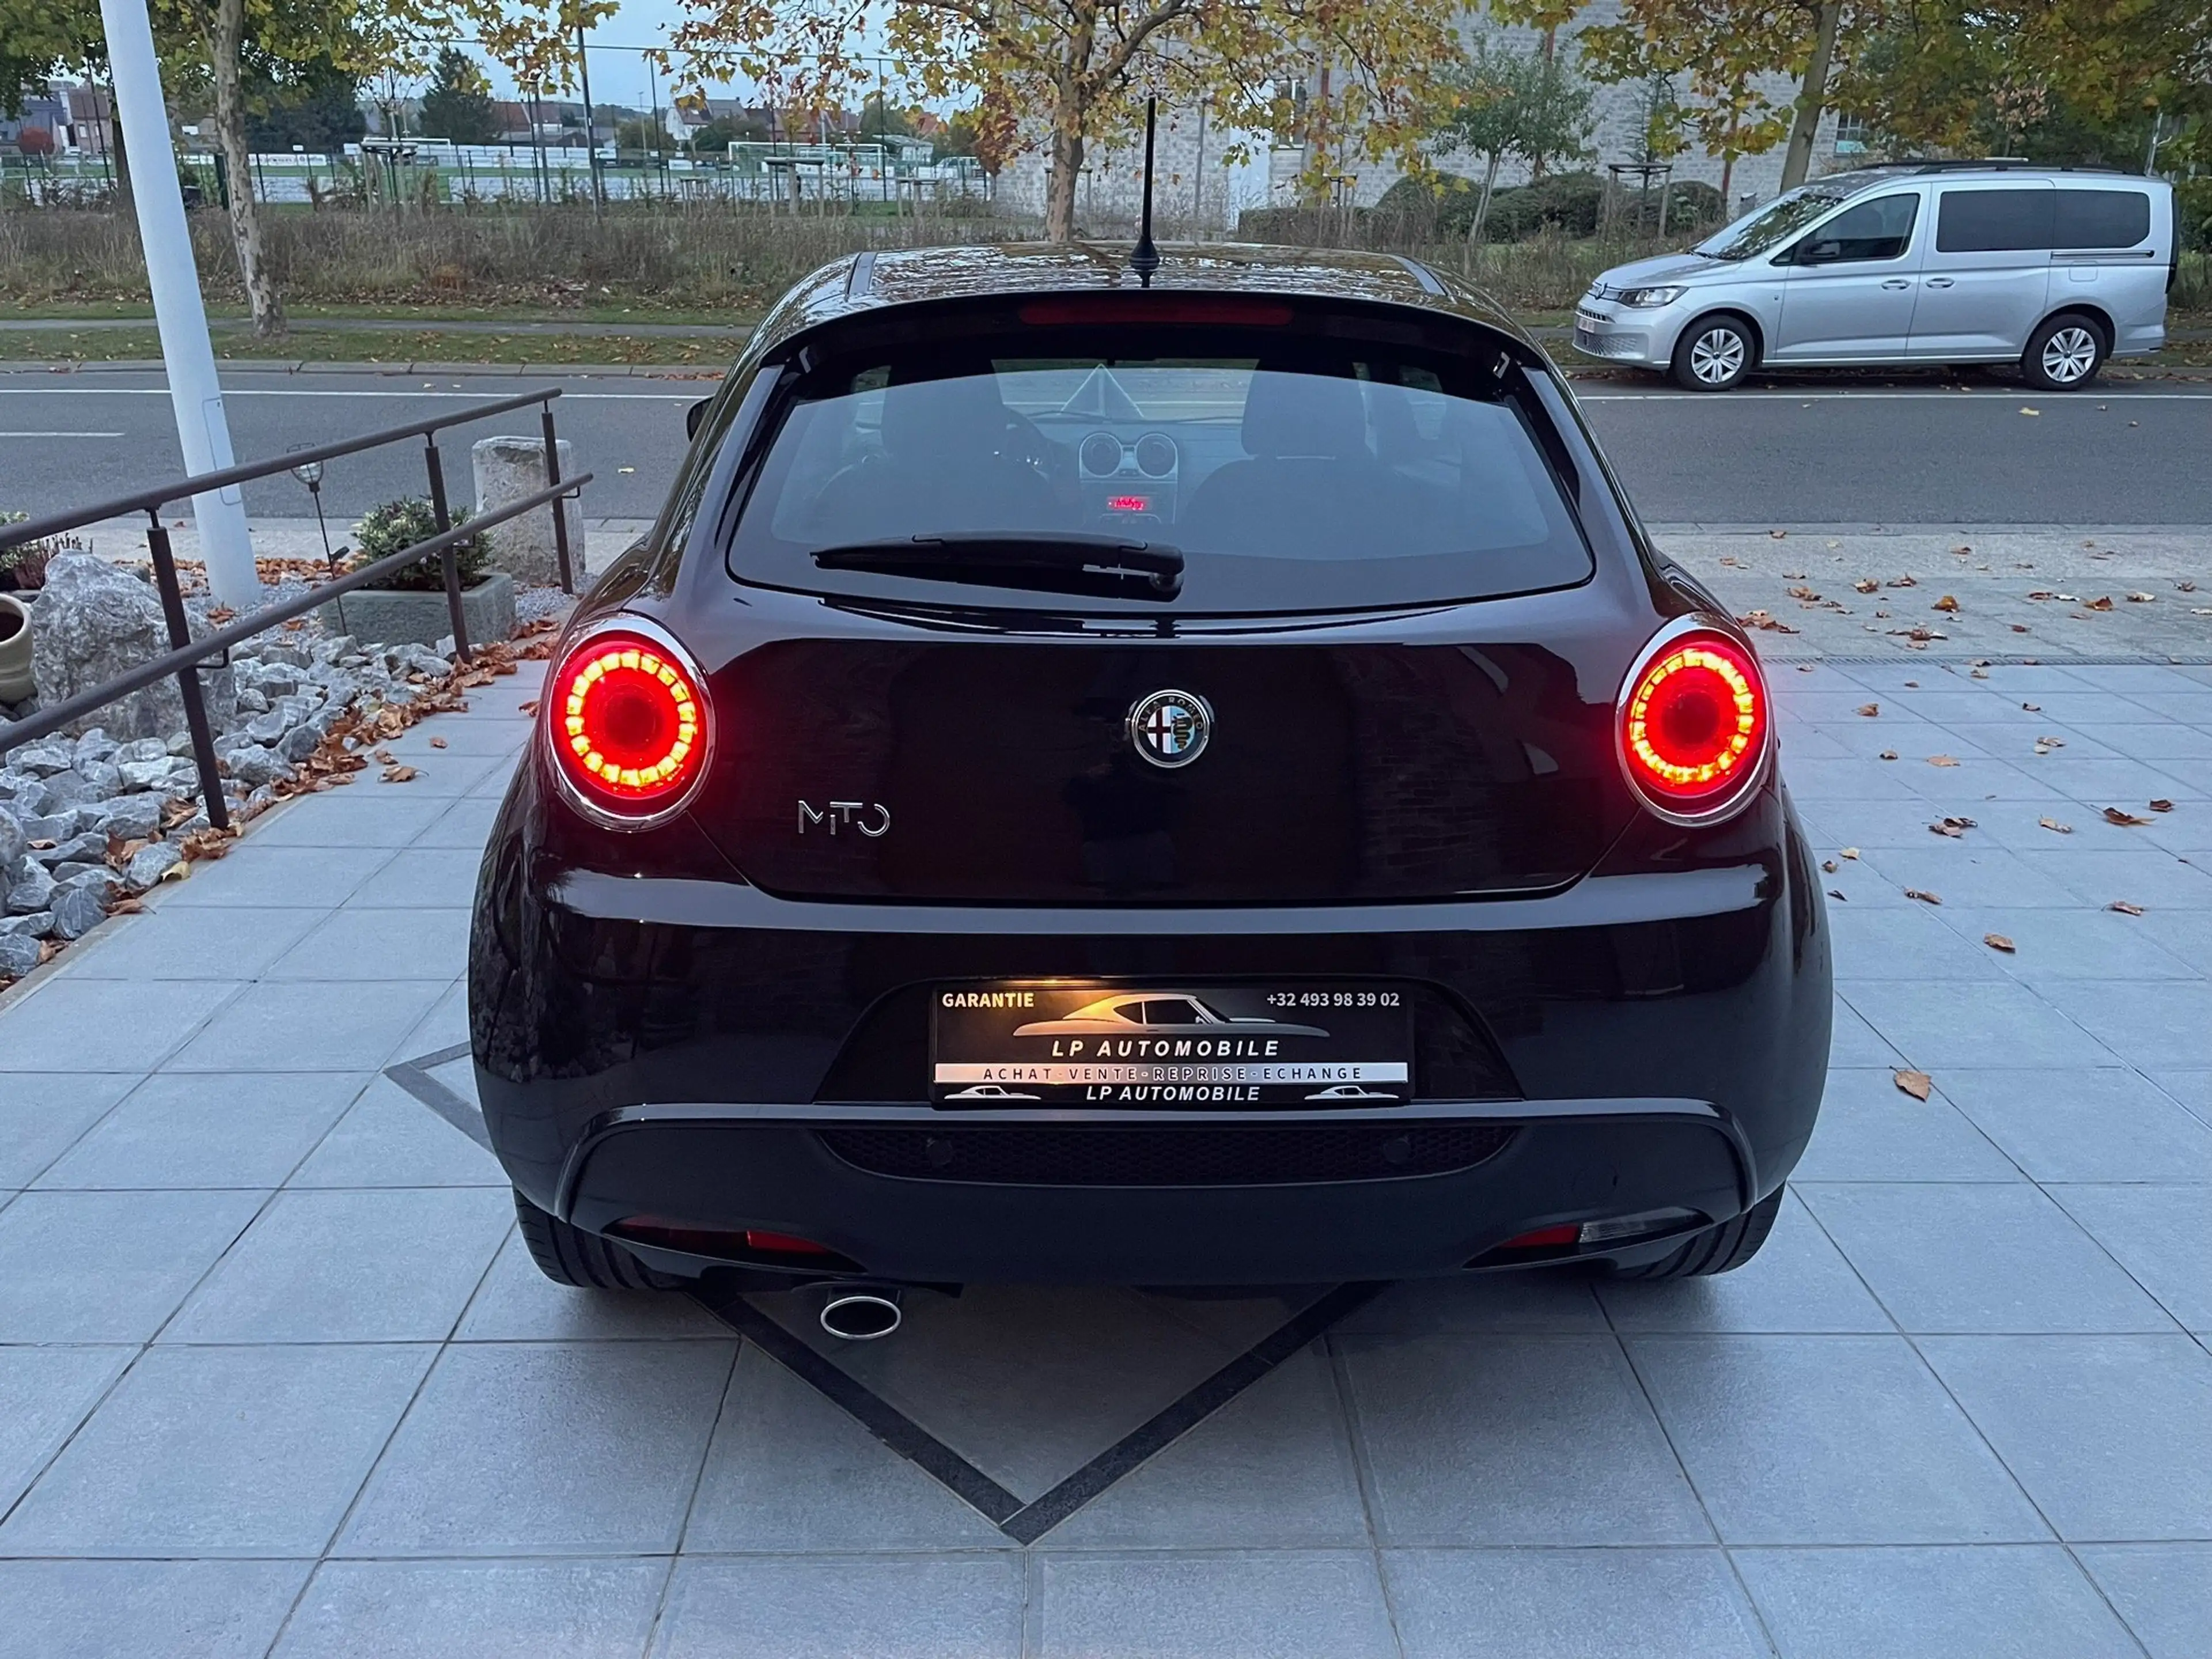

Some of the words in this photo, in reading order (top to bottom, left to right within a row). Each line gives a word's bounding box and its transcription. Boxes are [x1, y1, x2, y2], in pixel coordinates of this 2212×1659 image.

[1168, 696, 1203, 730] ROMEO
[942, 993, 1035, 1008] GARANTIE
[1267, 993, 1296, 1007] +32
[1300, 993, 1330, 1007] 493
[1333, 993, 1353, 1007] 98
[1357, 993, 1376, 1007] 39
[1380, 993, 1400, 1007] 02
[1052, 1040, 1084, 1056] LP
[1097, 1040, 1279, 1057] AUTOMOBILE
[1086, 1086, 1112, 1101] LP
[1119, 1086, 1260, 1101] AUTOMOBILE
